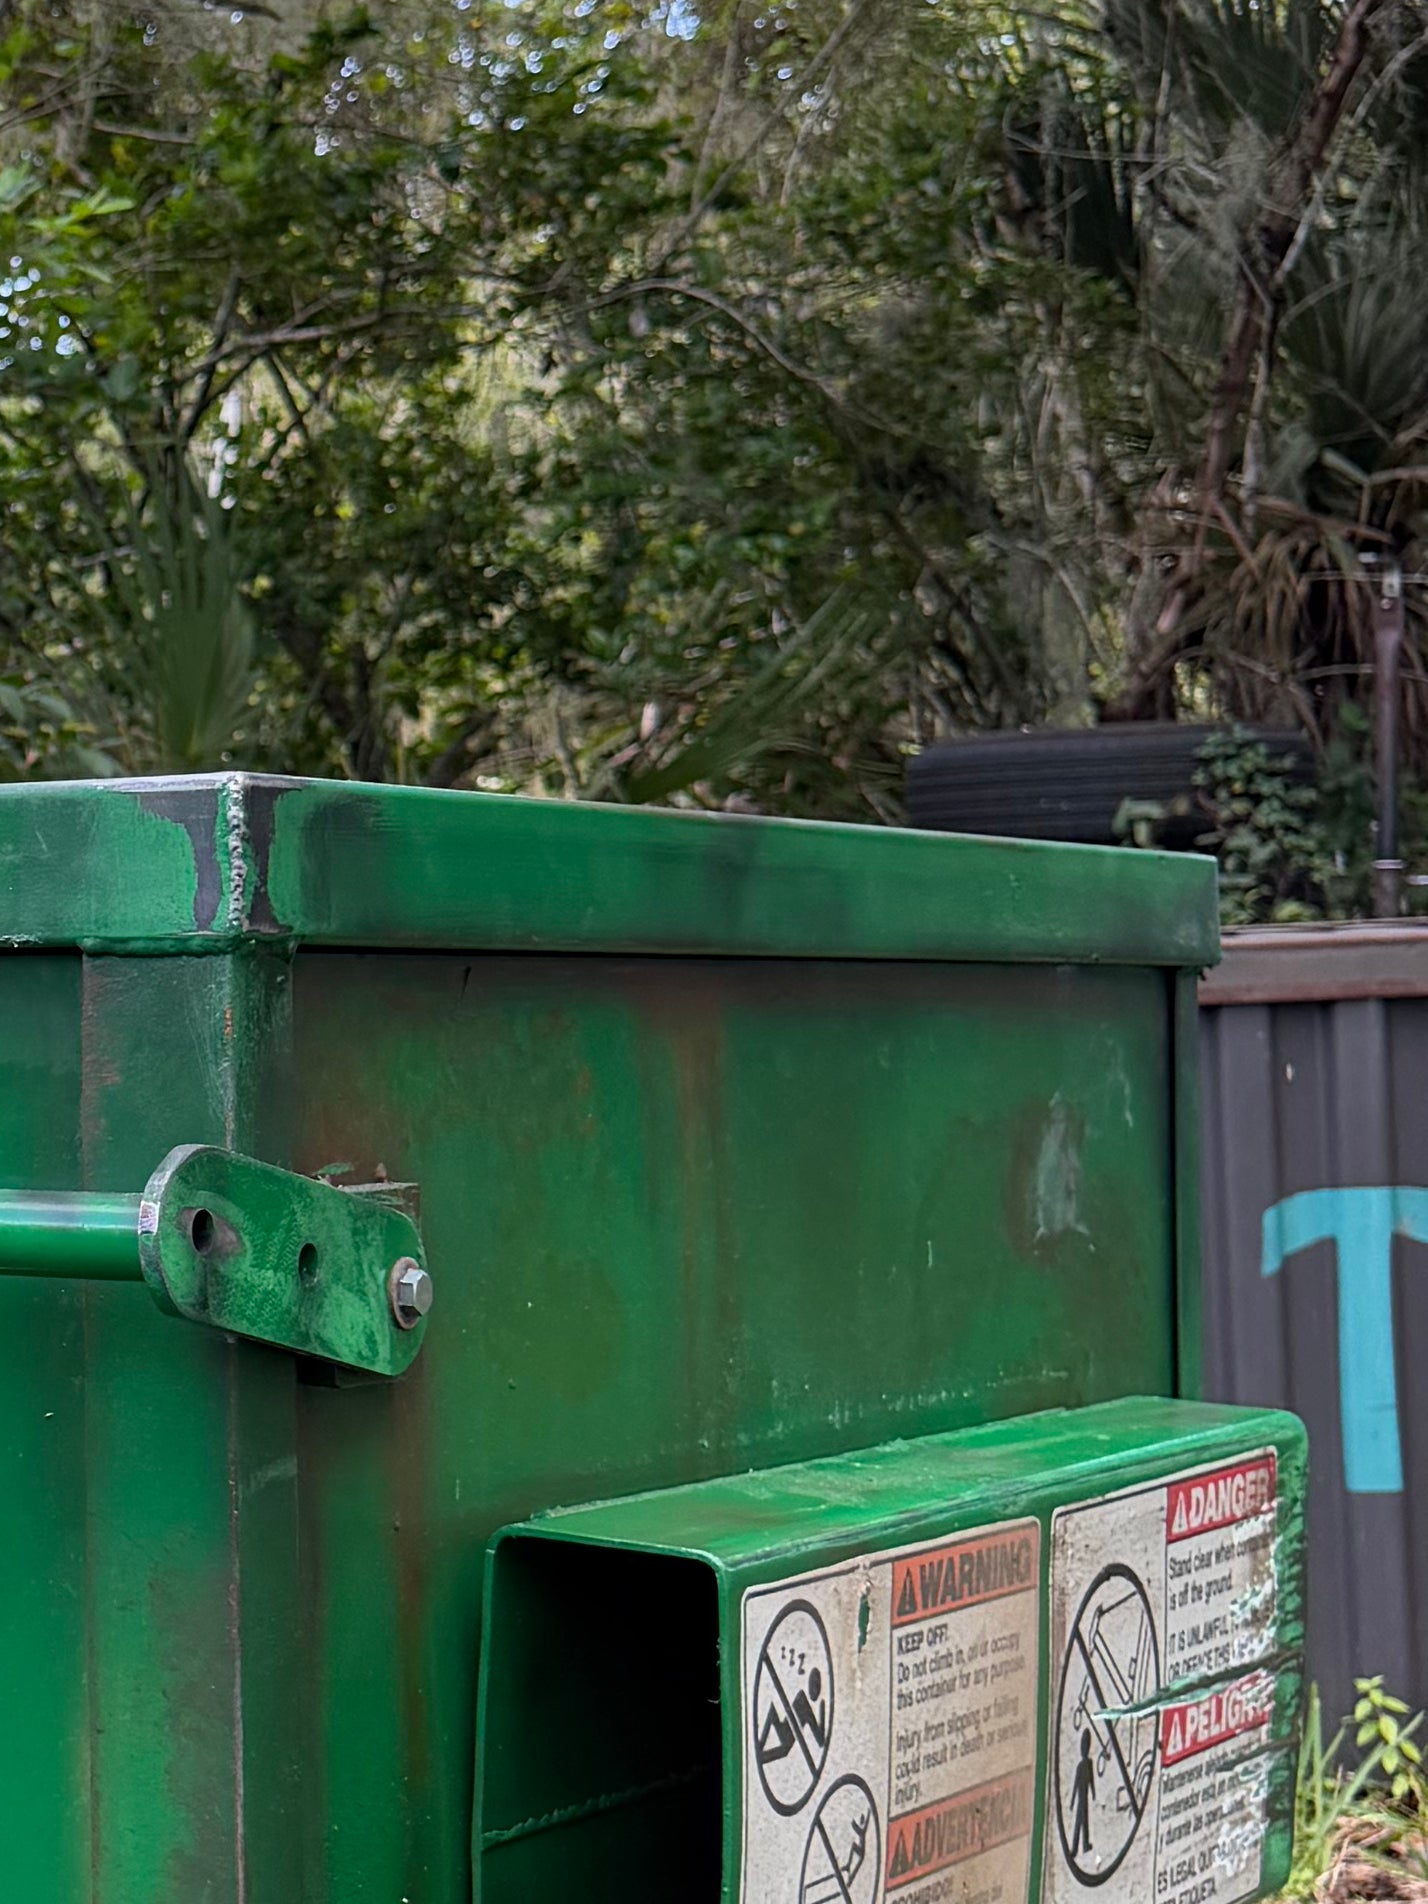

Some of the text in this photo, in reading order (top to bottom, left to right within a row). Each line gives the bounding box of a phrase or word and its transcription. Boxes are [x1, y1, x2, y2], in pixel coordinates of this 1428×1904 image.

[1189, 1467, 1269, 1528] DANGER
[919, 1538, 1031, 1610] WARNING
[1169, 1550, 1192, 1580] Stand
[1194, 1546, 1212, 1572] clear
[1215, 1539, 1235, 1564] when
[1191, 1578, 1203, 1604] the
[897, 1629, 923, 1656] KEEP
[897, 1662, 910, 1684] Do
[912, 1657, 926, 1679] not
[929, 1648, 953, 1674] climb
[897, 1688, 913, 1710] this
[915, 1677, 957, 1704] container
[958, 1670, 971, 1689] for
[973, 1667, 989, 1687] any
[924, 1720, 945, 1742] from
[1185, 1690, 1256, 1749] PELIG
[896, 1752, 920, 1780] could
[923, 1743, 947, 1769] result
